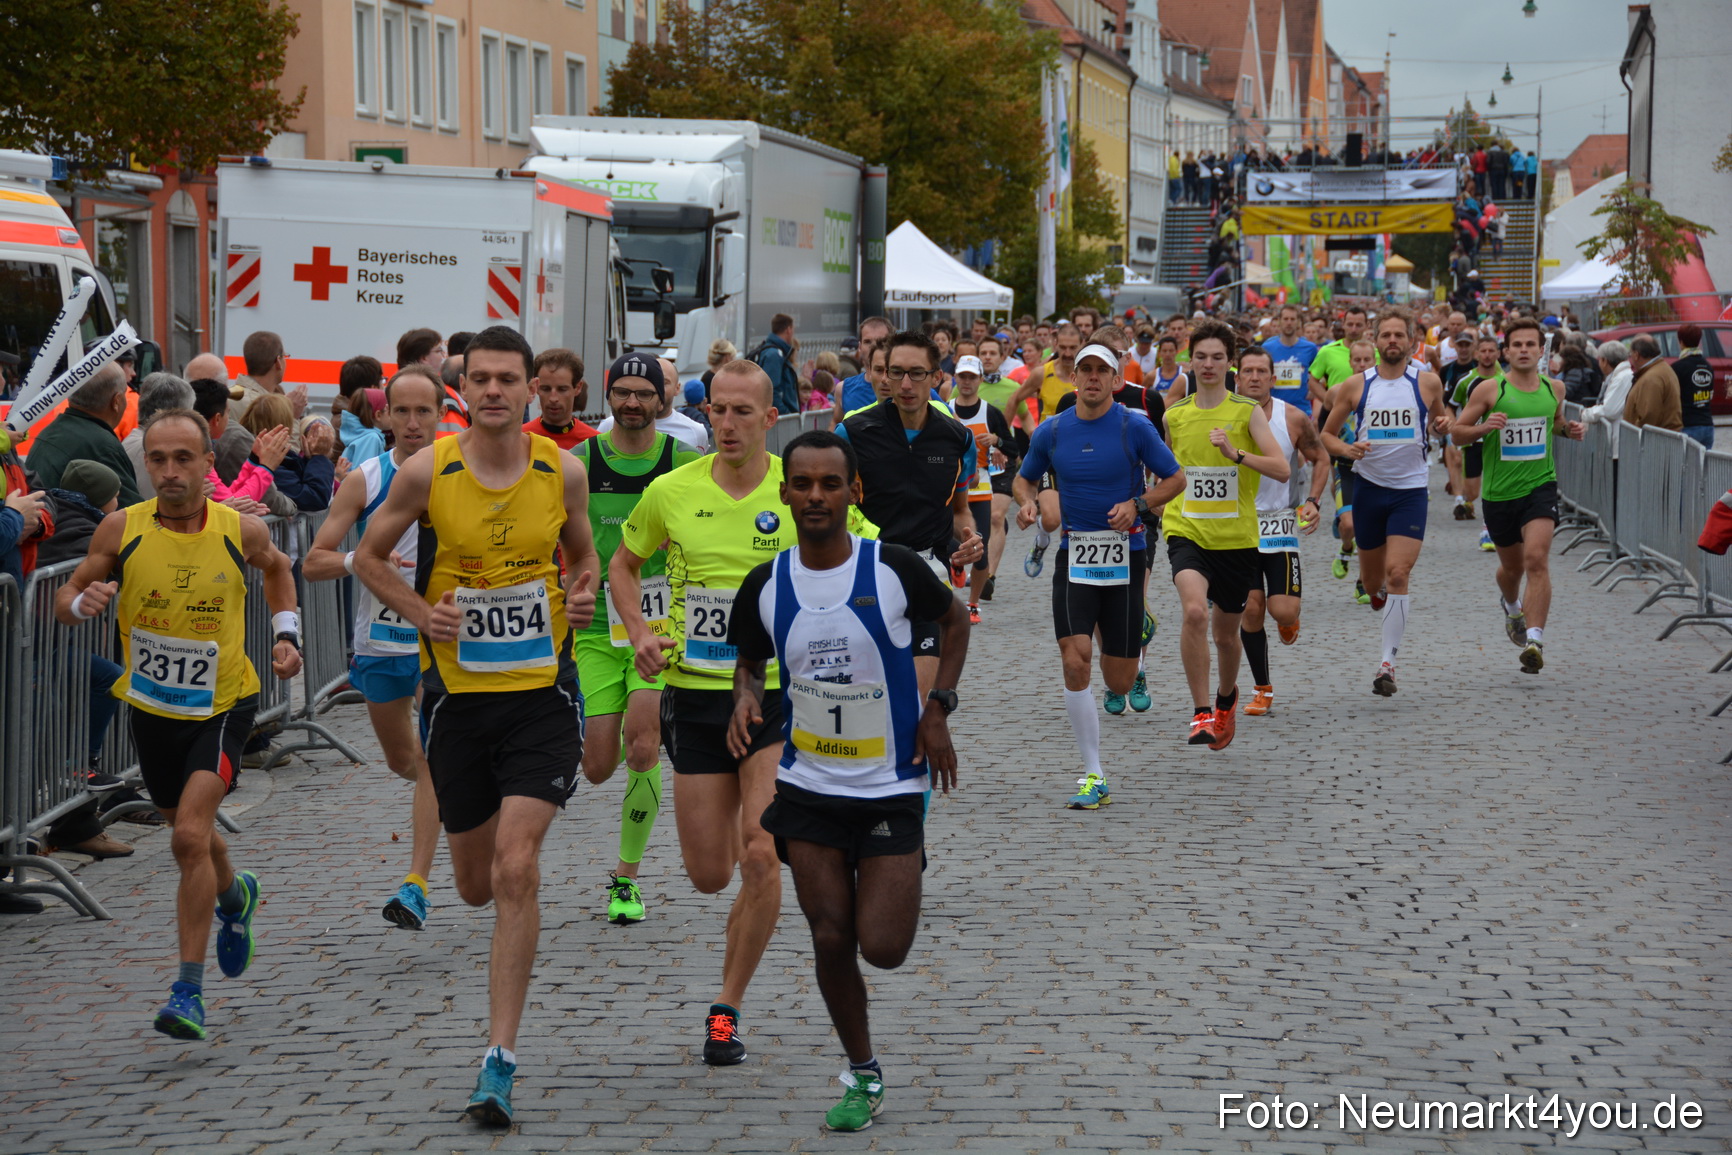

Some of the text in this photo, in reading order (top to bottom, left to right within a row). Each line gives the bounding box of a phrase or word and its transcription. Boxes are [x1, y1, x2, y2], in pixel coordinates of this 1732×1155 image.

[569, 179, 659, 201] OCK
[1309, 211, 1382, 229] START
[482, 235, 516, 245] 44/54/1
[823, 209, 851, 271] BOCK
[358, 248, 458, 266] Bayerisches
[357, 269, 404, 284] Rotes
[356, 290, 404, 305] Kreuz
[892, 290, 957, 305] Laufsport
[19, 333, 129, 423] bmw-laufsport.de
[1281, 369, 1293, 379] 46
[1370, 409, 1411, 427] 2016
[1505, 427, 1542, 445] 3117
[1194, 479, 1227, 498] 533
[1260, 519, 1295, 536] 2207
[753, 537, 780, 547] Partl
[1075, 543, 1124, 565] 2273
[459, 560, 483, 570] Seidl
[1084, 569, 1115, 578] Thomas
[457, 591, 536, 604] PARTL Neumarkt
[687, 594, 712, 604] PARTL
[138, 614, 147, 624] M
[162, 618, 170, 628] S
[195, 622, 218, 630] ELIO
[466, 602, 546, 639] 3054
[650, 622, 664, 633] iel
[132, 634, 203, 655] PARTL Neumarkt
[808, 637, 848, 650] FINISH LINE
[139, 648, 209, 686] 2312
[811, 655, 851, 666] FALKE
[814, 672, 853, 683] PowerBar
[150, 685, 187, 704] Jürgen
[792, 682, 869, 701] PARTL Neumarkt
[828, 705, 841, 735] 1
[815, 740, 858, 756] Addisu
